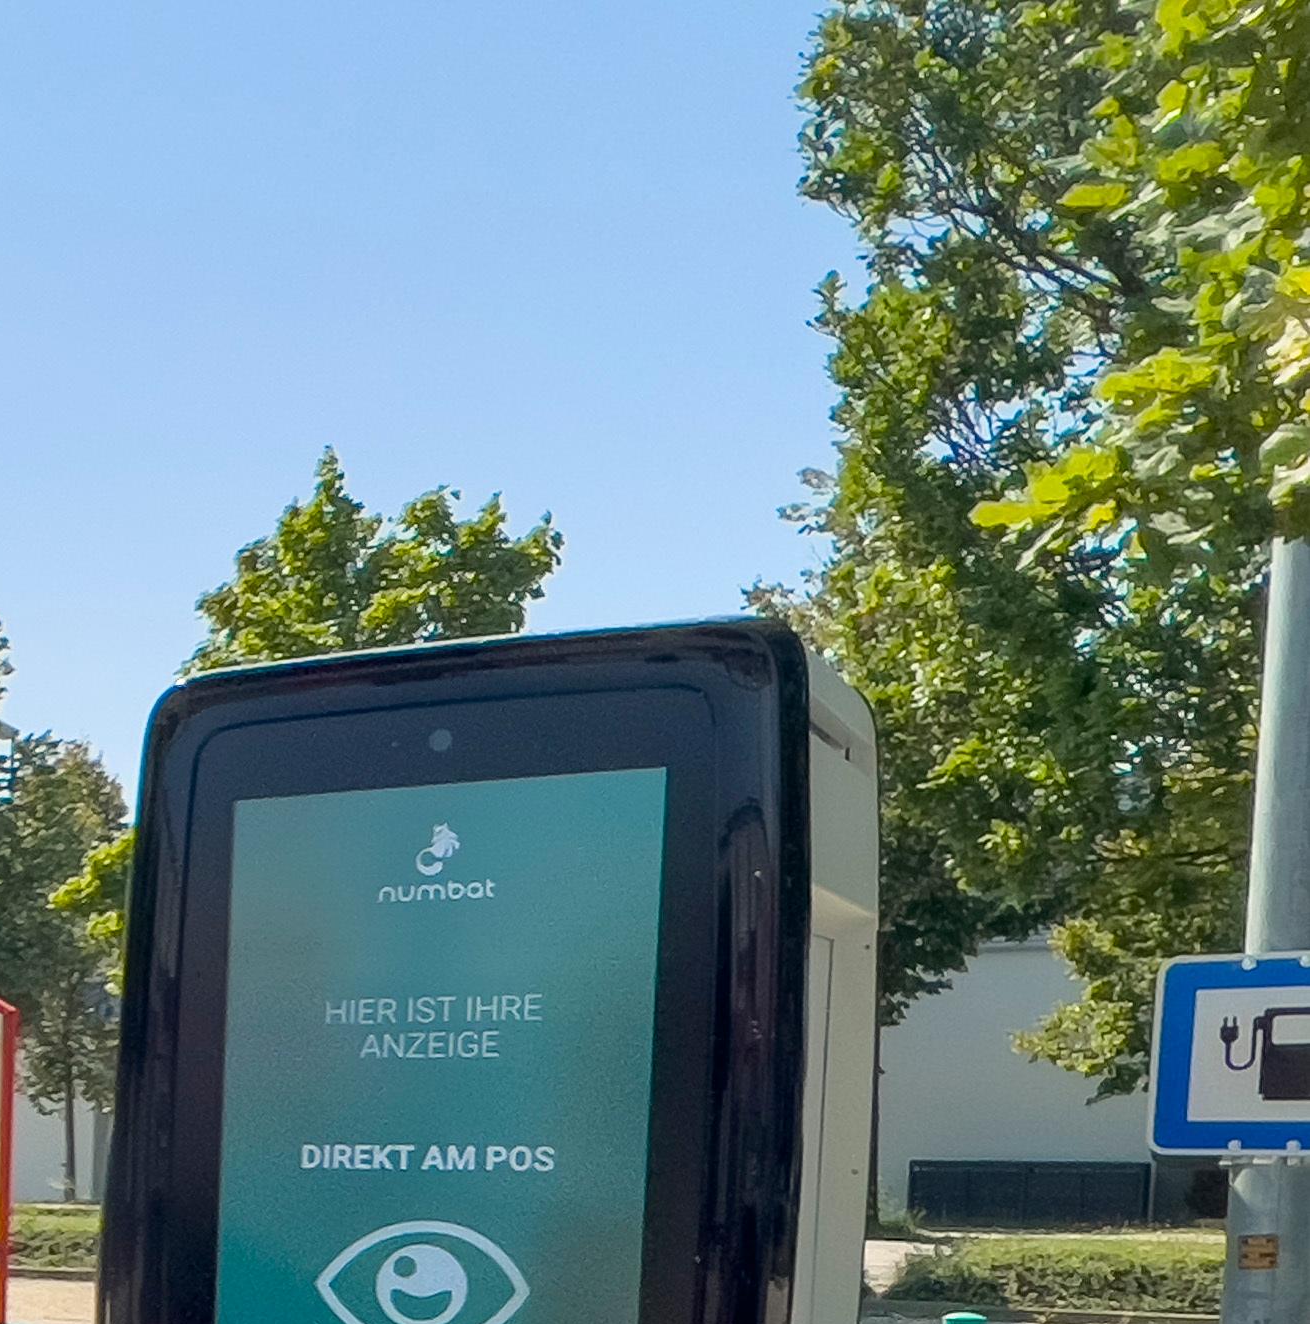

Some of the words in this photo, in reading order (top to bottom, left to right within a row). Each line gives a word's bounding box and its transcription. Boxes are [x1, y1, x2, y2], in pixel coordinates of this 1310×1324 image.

[377, 879, 496, 903] numbat
[325, 998, 397, 1025] HIER
[407, 996, 457, 1023] IST
[466, 994, 543, 1021] IHRE
[360, 1031, 500, 1058] ANZEIGE
[301, 1144, 415, 1170] DIREKT
[421, 1145, 475, 1171] AM
[486, 1146, 555, 1172] POS
